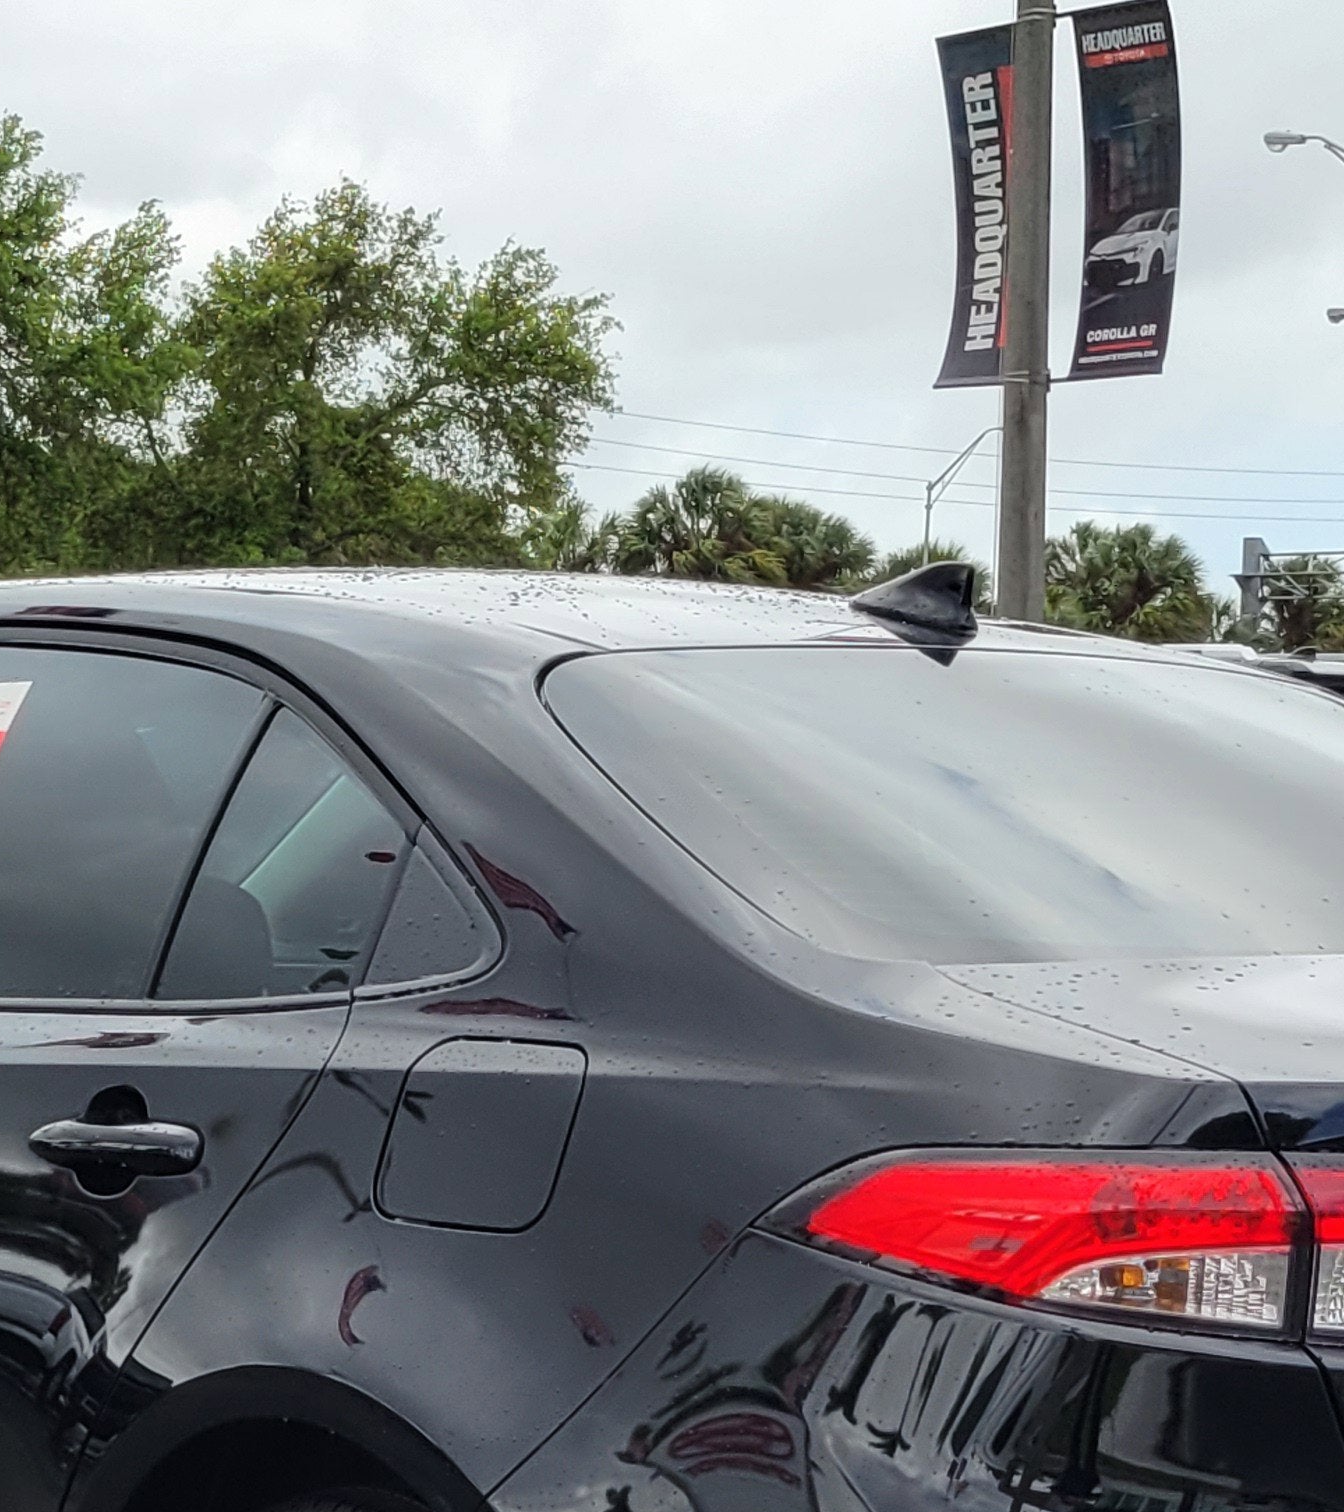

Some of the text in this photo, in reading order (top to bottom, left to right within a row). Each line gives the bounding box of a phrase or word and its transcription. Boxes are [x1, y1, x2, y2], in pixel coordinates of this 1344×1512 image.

[1082, 21, 1167, 54] HEADQUARTER
[963, 71, 1007, 352] HEADQUARTER
[1086, 323, 1157, 343] COROLLA GR
